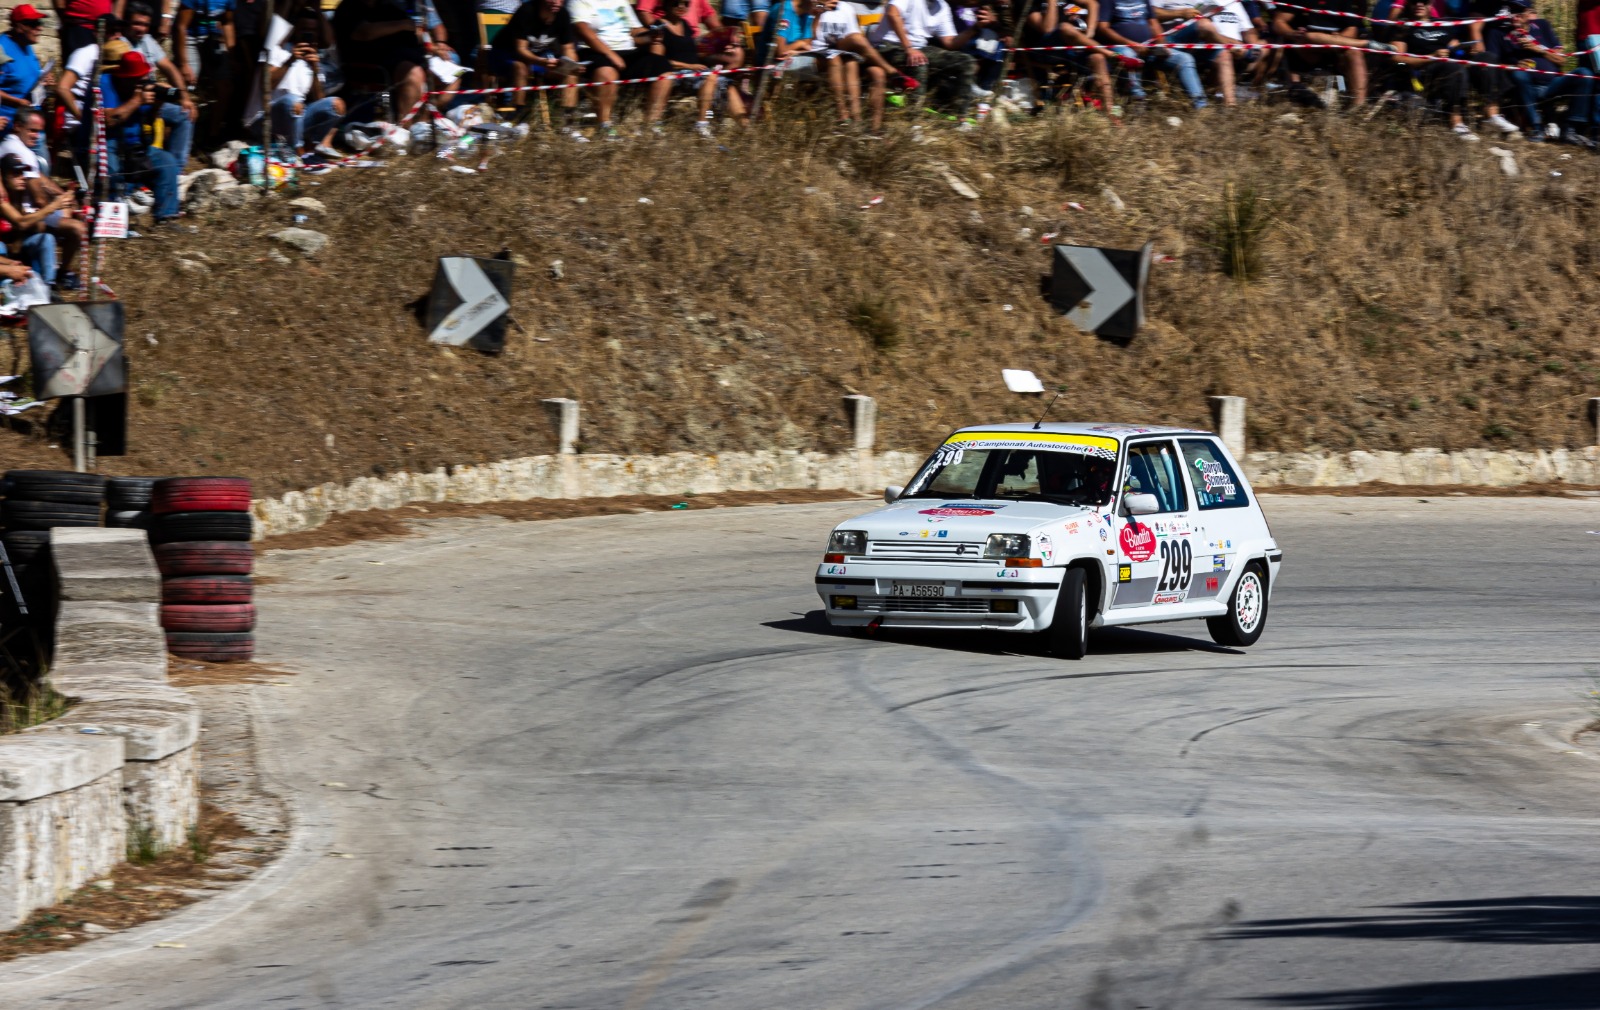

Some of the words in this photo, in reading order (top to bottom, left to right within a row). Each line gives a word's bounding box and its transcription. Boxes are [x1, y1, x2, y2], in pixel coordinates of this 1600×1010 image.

[1027, 442, 1082, 451] Autostoriche
[936, 450, 964, 466] 299
[1157, 539, 1192, 591] 299
